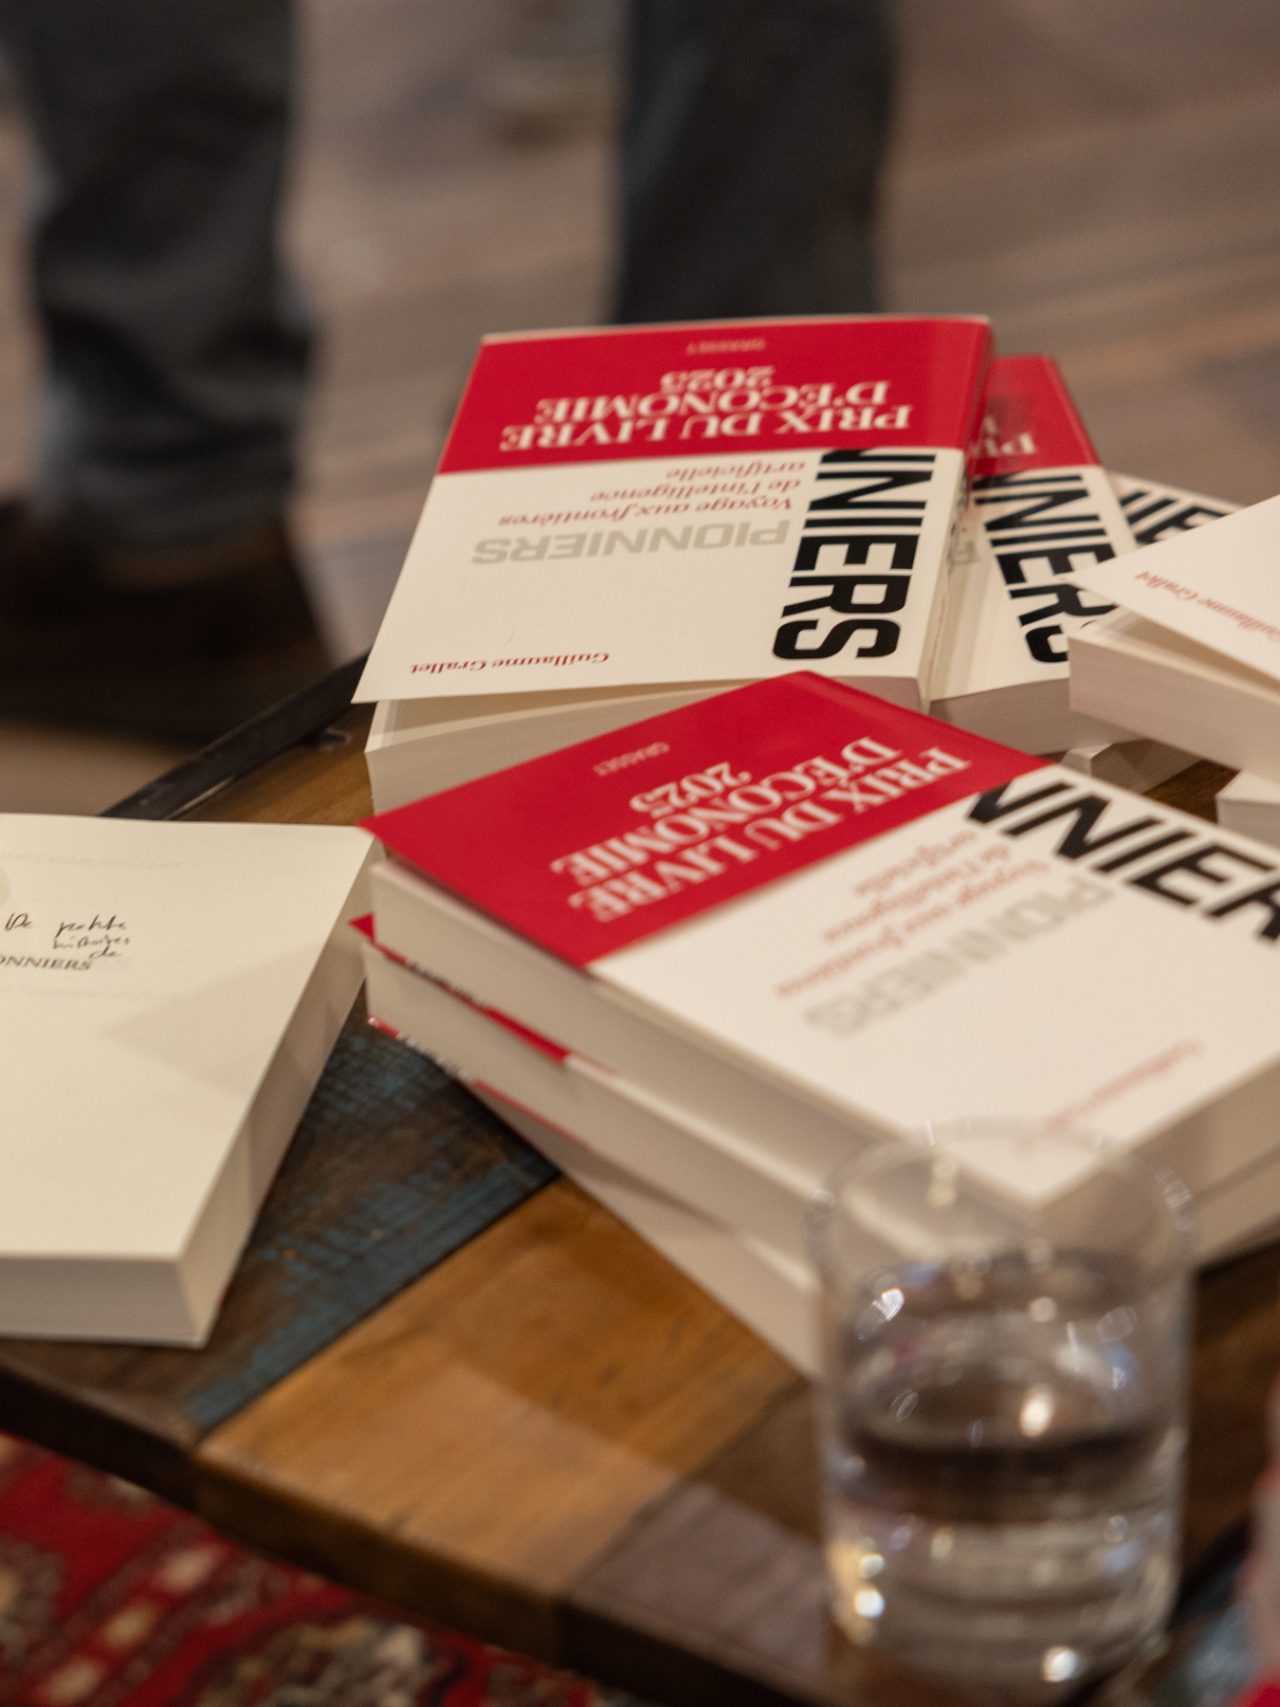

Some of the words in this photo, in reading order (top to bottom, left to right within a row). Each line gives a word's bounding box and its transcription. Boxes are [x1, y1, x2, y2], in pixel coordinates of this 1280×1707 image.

[661, 366, 775, 394] 2025
[499, 415, 671, 452] LIVRE
[680, 411, 763, 440] DU
[774, 404, 914, 435] PRIX
[666, 461, 806, 479] artificielle
[769, 478, 802, 493] de
[635, 501, 691, 515] aux
[696, 496, 794, 513] Voyage
[471, 520, 792, 565] PIONNIERS
[409, 659, 488, 674] Grallet
[491, 652, 610, 668] Guillaume
[629, 761, 752, 819] 2025
[820, 746, 972, 814] PRIX
[743, 799, 843, 852] DU
[568, 834, 759, 923] LIVRE
